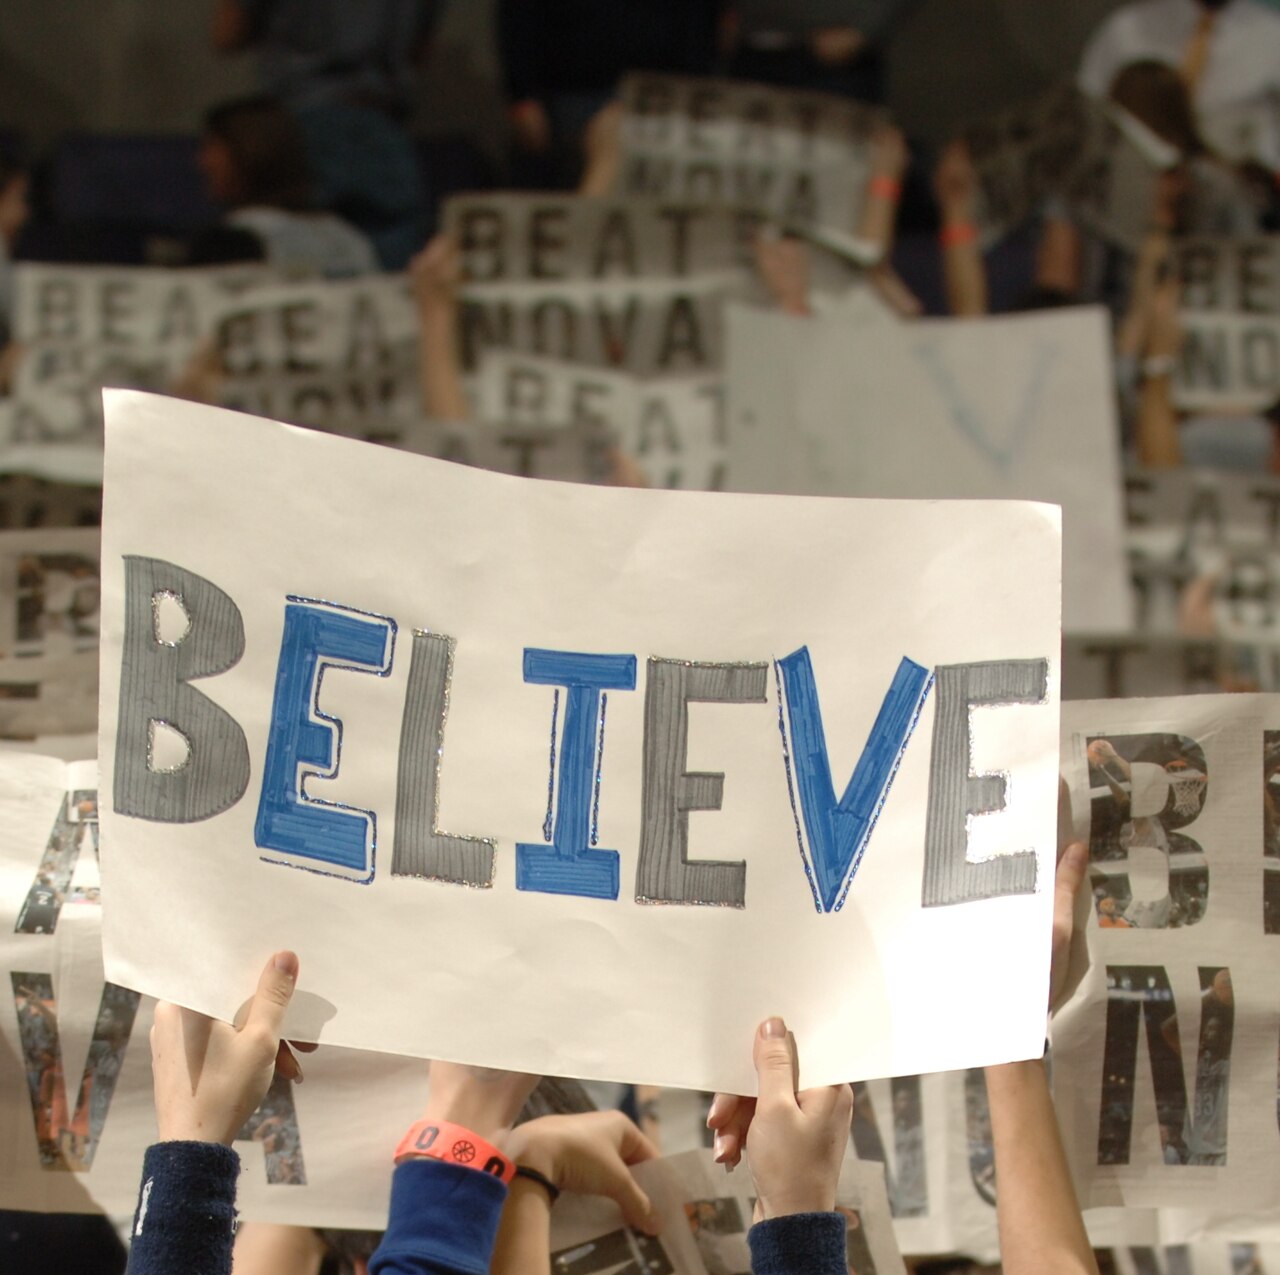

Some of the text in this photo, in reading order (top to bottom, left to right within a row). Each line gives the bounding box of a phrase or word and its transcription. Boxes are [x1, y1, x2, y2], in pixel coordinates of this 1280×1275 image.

[460, 206, 698, 281] BEAT
[38, 280, 196, 343] BEA
[217, 296, 396, 376] BEA
[456, 296, 708, 374] NOVA
[111, 554, 1051, 913] BELIEVE
